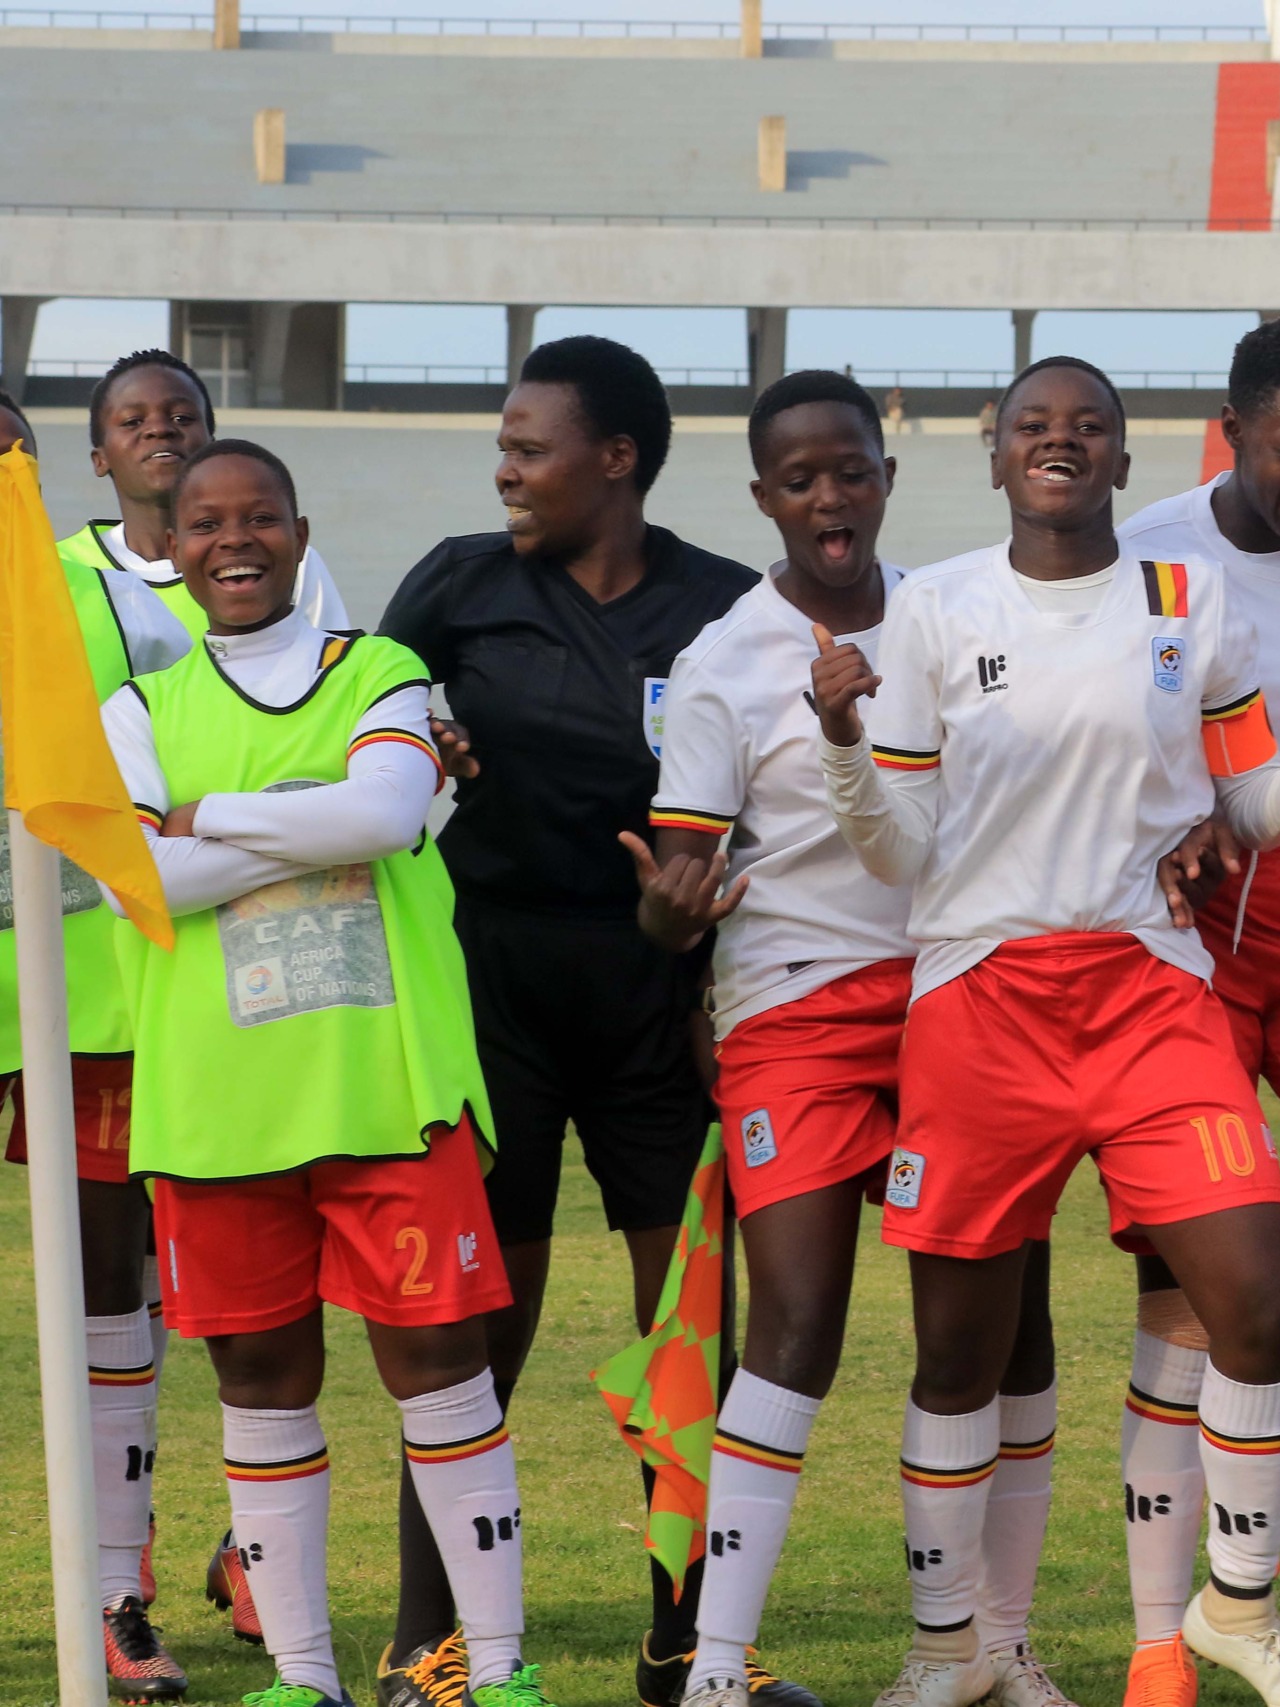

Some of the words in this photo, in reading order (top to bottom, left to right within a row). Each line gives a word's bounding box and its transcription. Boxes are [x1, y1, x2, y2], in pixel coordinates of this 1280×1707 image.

[255, 908, 355, 944] CAF
[290, 945, 345, 967] AFRICA
[292, 966, 323, 984] CUP
[295, 986, 316, 1001] OF
[319, 982, 377, 997] NATIONS
[1189, 1113, 1256, 1182] 10
[394, 1226, 434, 1296] 2
